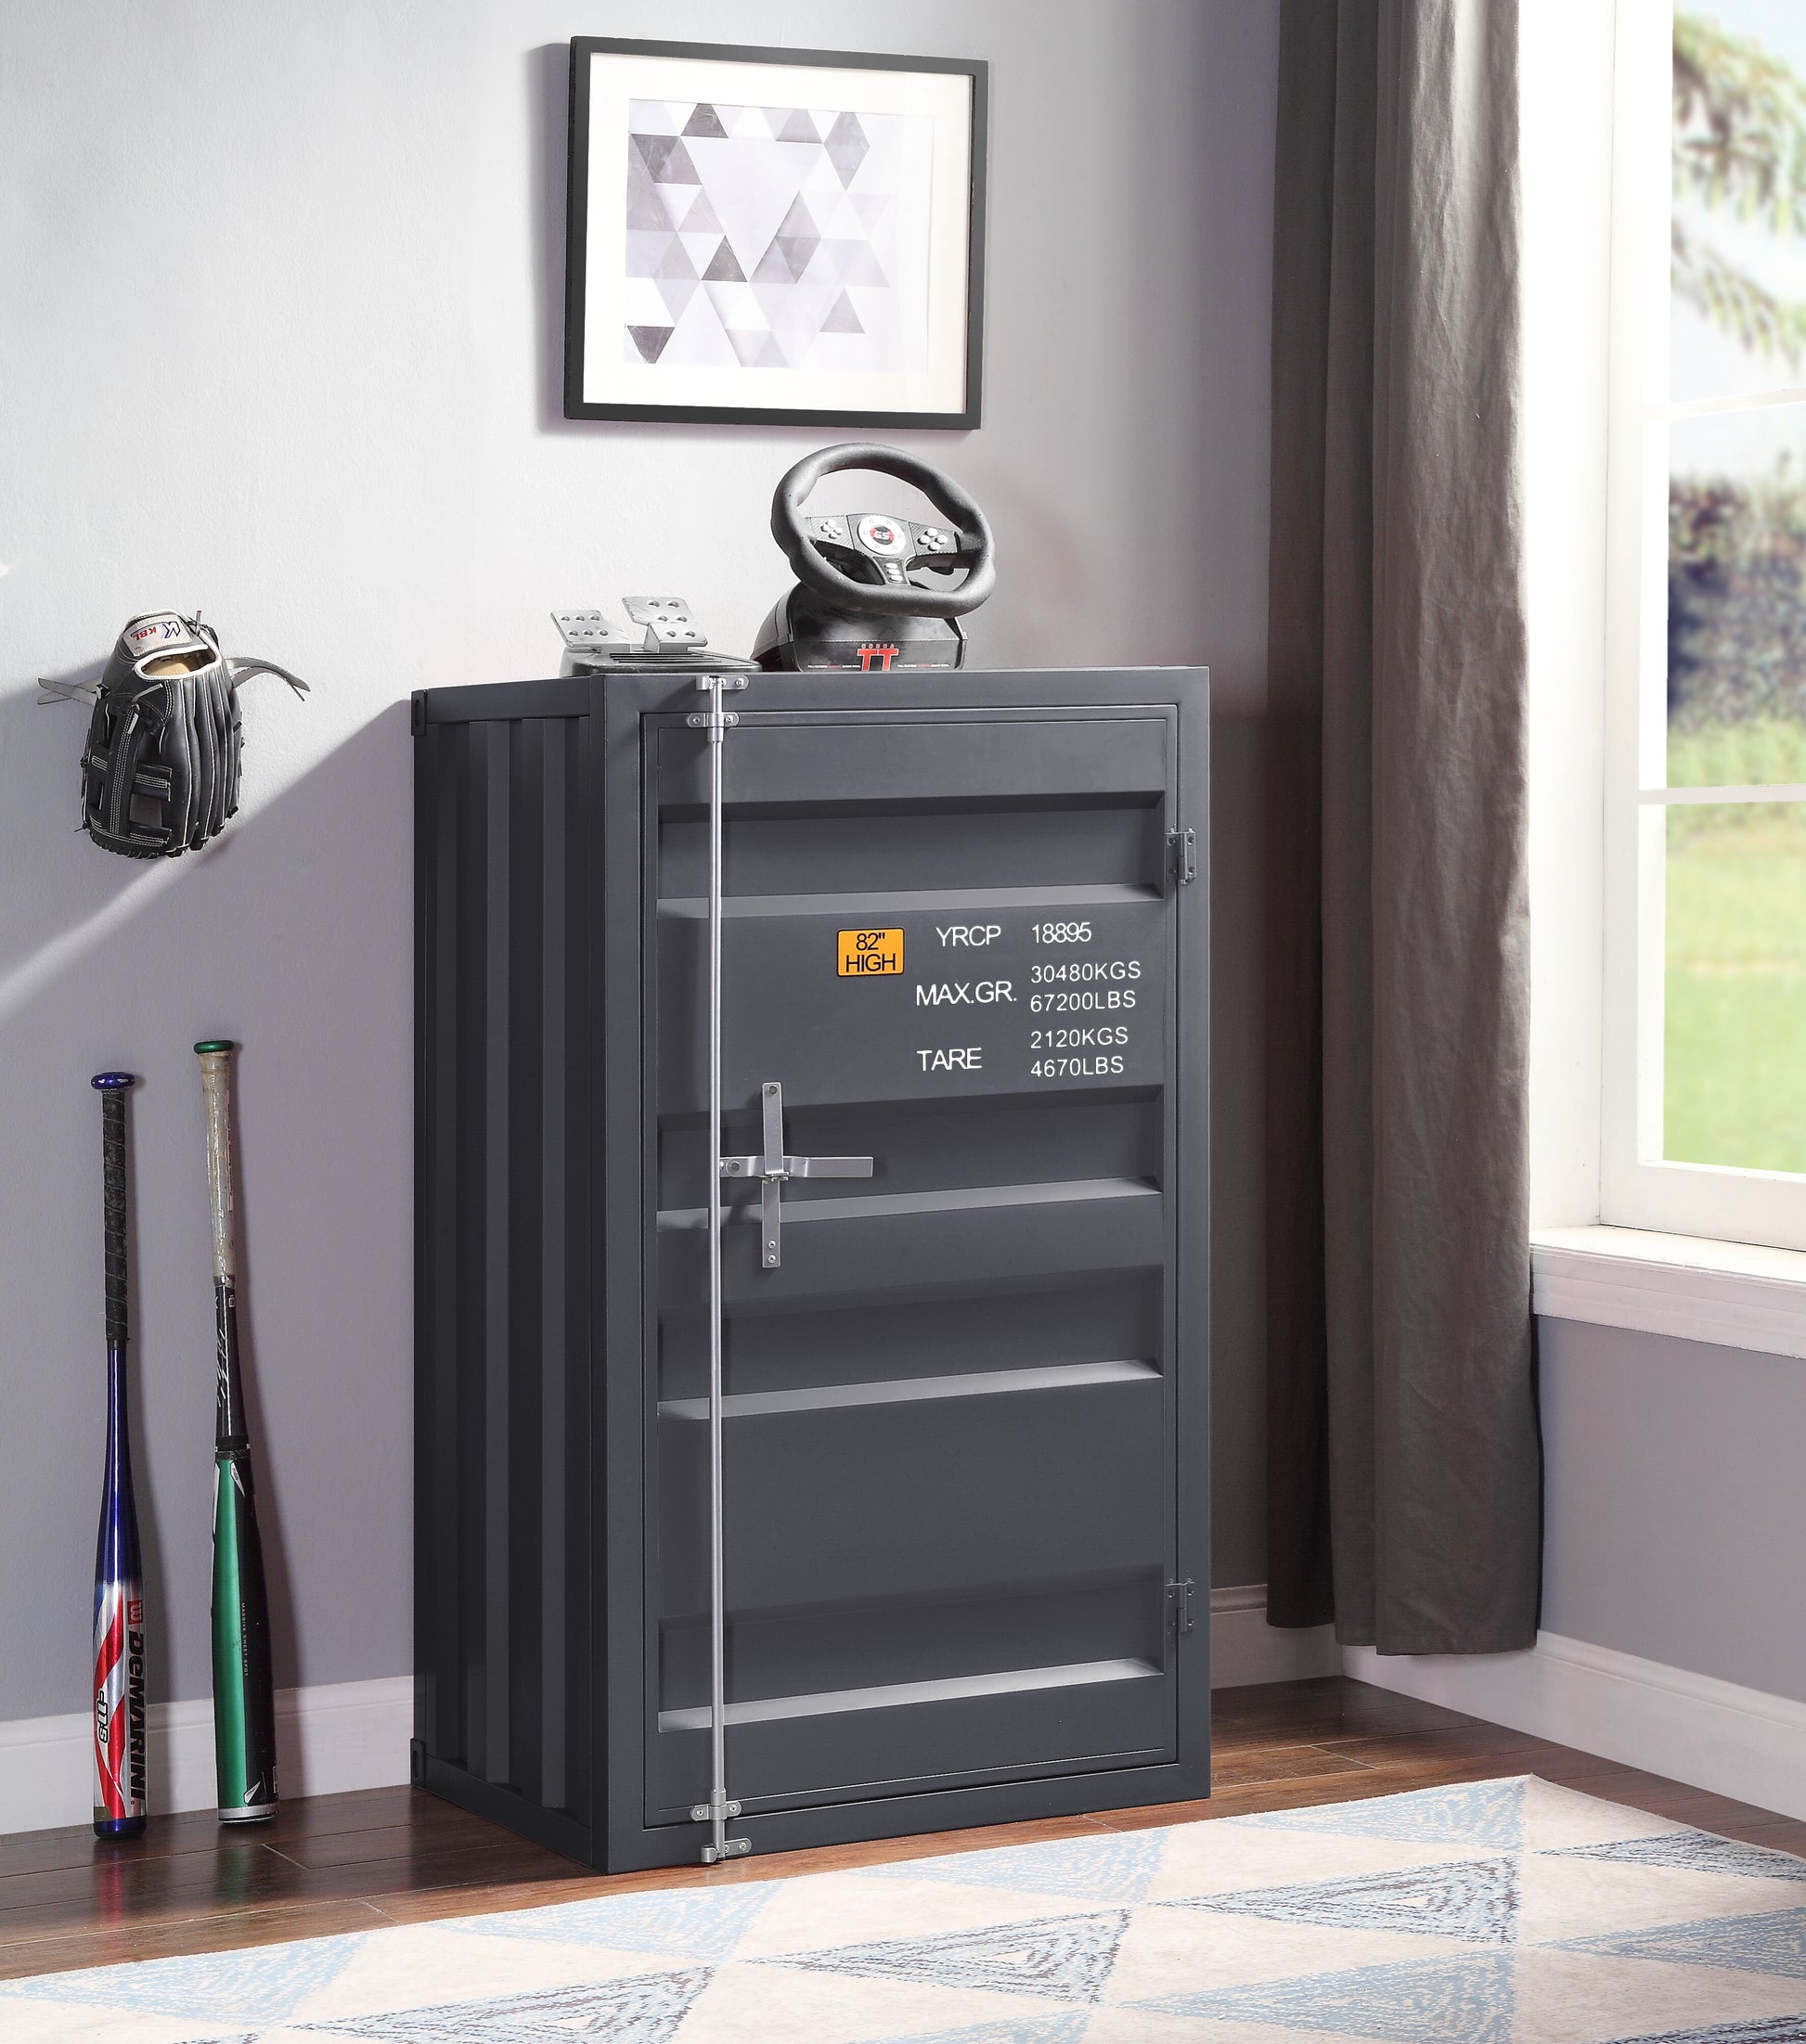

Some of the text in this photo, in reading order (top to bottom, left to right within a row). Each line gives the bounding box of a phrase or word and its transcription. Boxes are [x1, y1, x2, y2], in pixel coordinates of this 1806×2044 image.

[874, 531, 890, 540] GS
[133, 626, 157, 641] KBL
[857, 649, 899, 671] TT
[856, 932, 886, 951] 82"
[936, 921, 1092, 946] YRCP 18895
[845, 954, 897, 972] HIGH
[1030, 960, 1142, 983] 30480KGS
[916, 981, 1017, 1006] MAX.GR.
[1030, 990, 1136, 1012] 67200LBS
[1030, 1026, 1129, 1049] 2120KGS
[917, 1048, 982, 1071] TARE
[1030, 1055, 1124, 1077] 4670LBS
